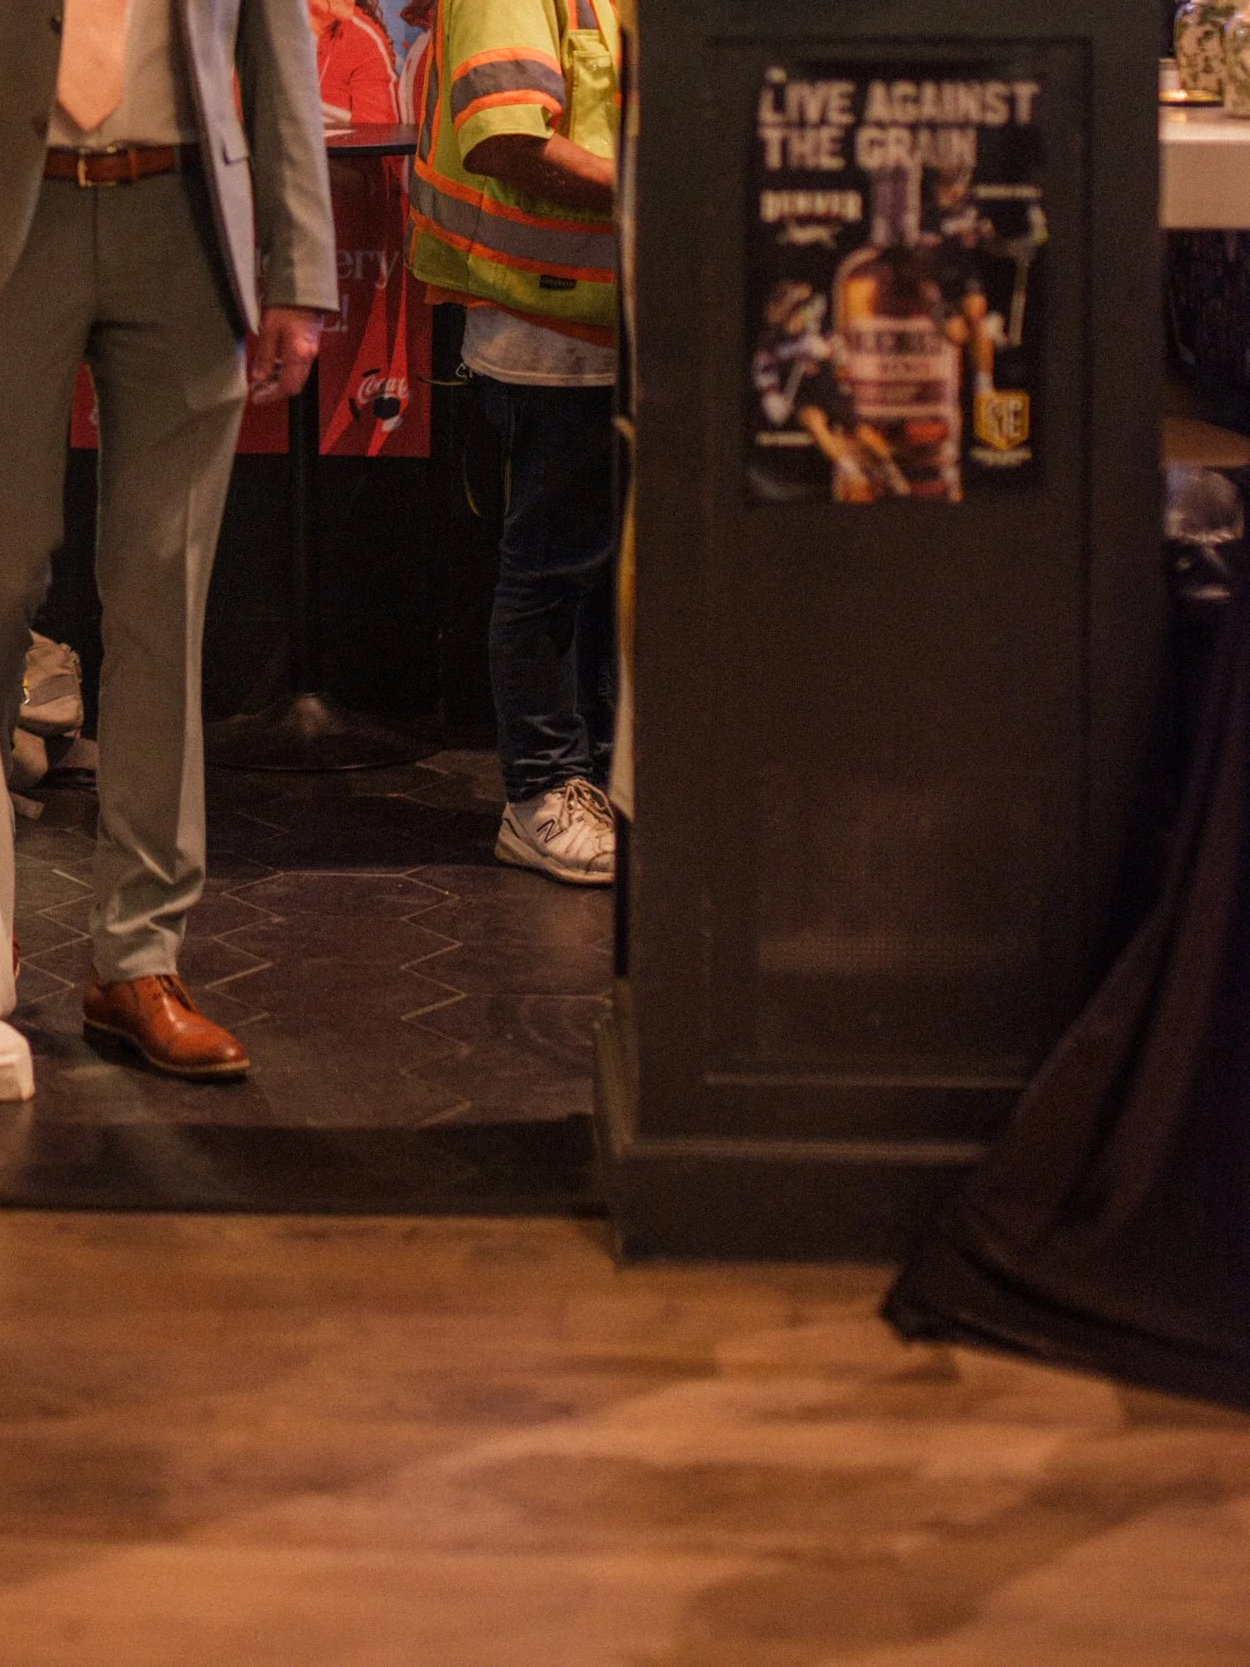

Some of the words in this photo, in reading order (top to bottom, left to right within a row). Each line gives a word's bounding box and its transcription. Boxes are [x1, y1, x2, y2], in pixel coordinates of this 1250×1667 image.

[758, 79, 856, 125] LIVE
[865, 78, 1040, 125] AGAINST
[758, 126, 847, 171] THE
[855, 126, 978, 171] GRAIN
